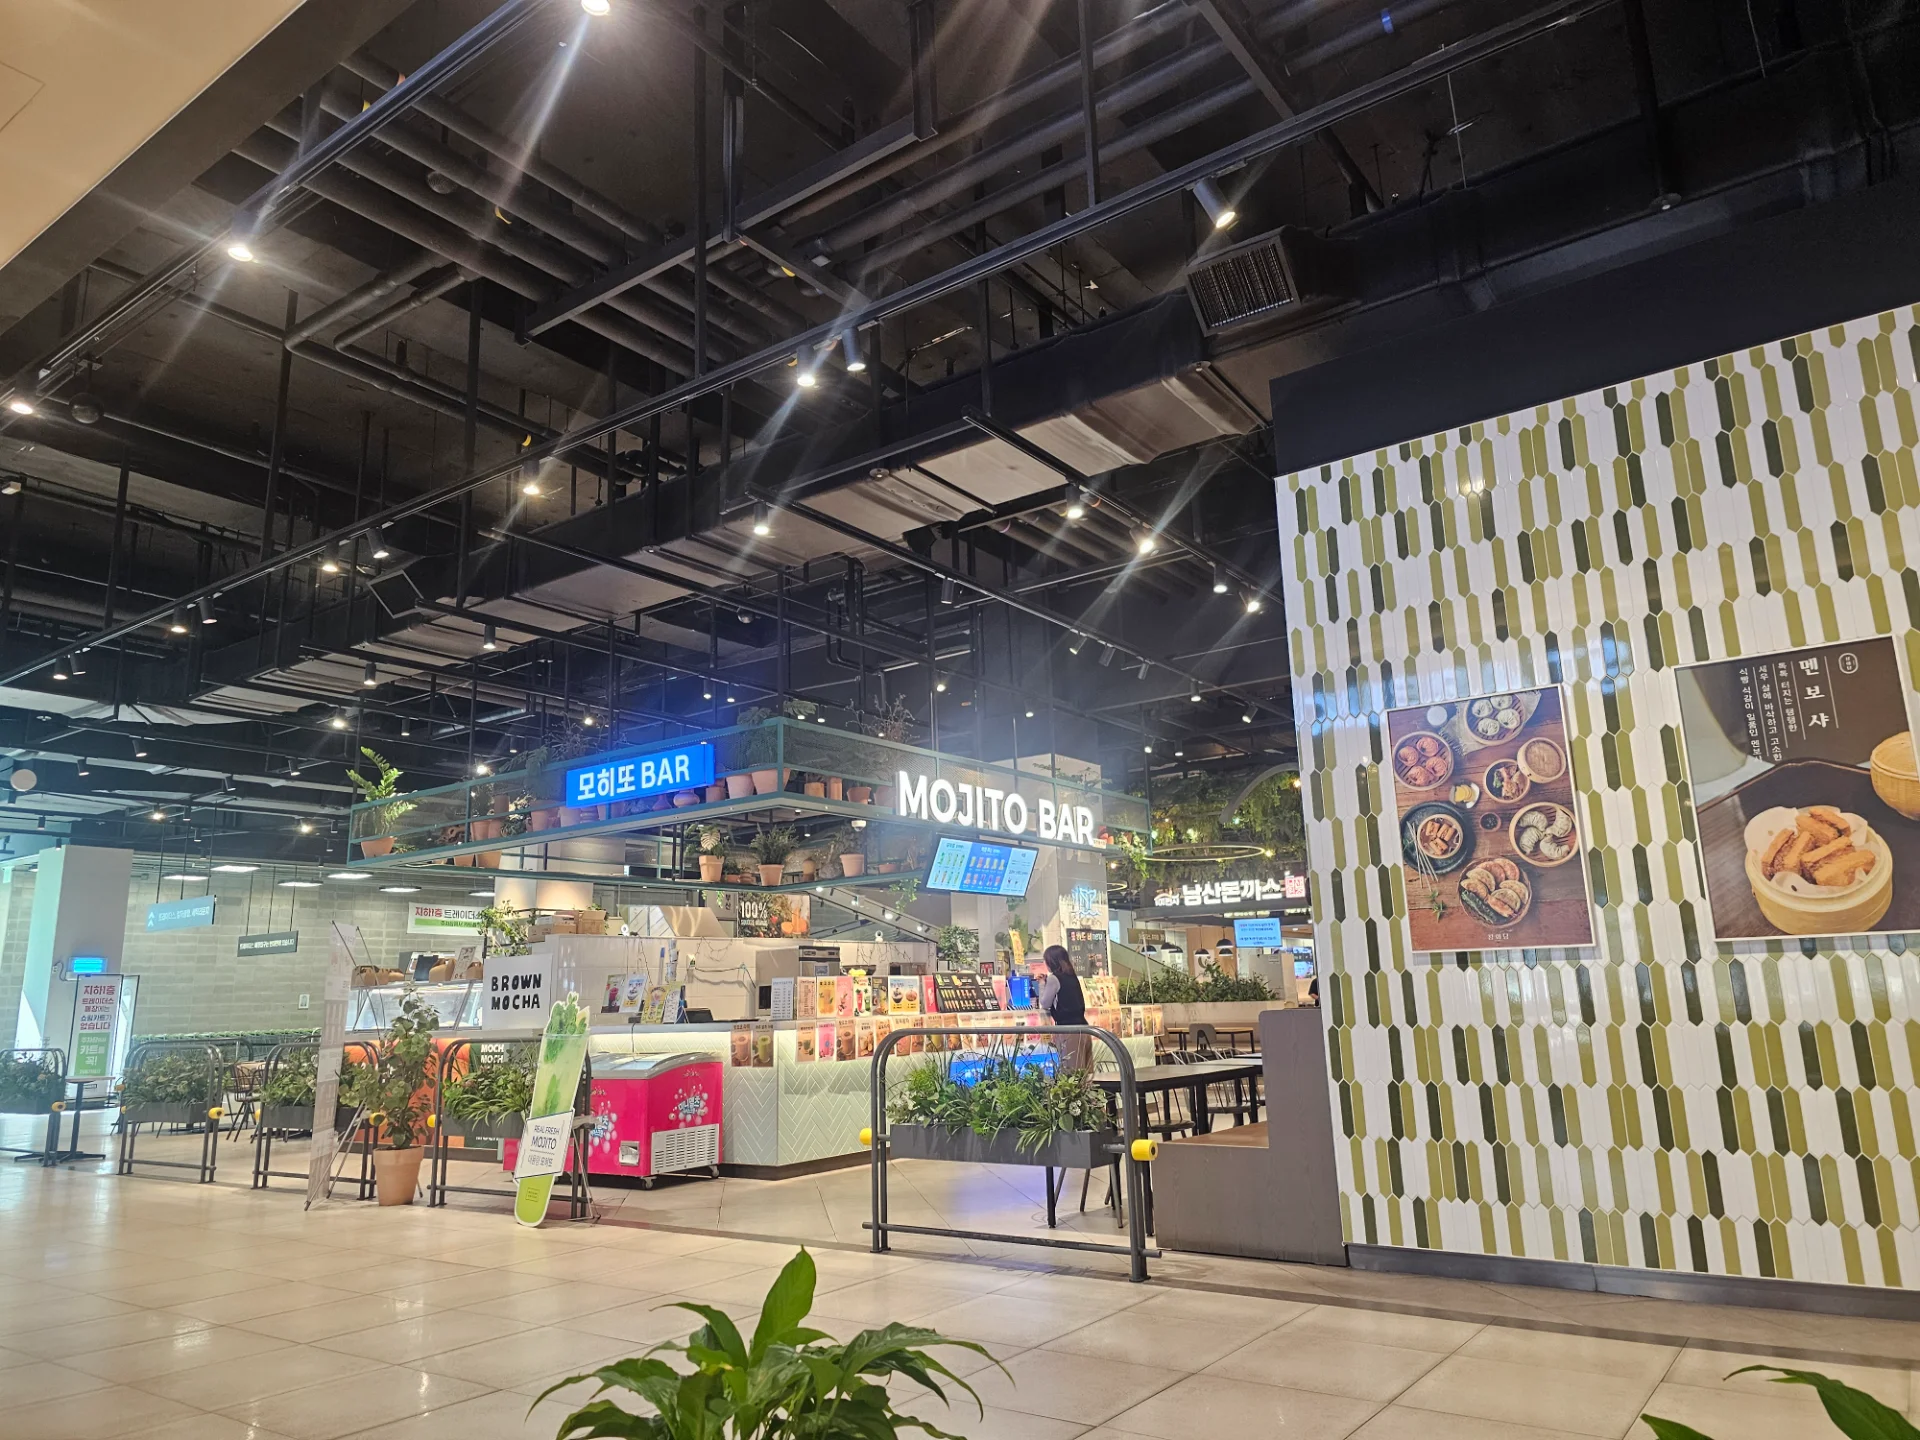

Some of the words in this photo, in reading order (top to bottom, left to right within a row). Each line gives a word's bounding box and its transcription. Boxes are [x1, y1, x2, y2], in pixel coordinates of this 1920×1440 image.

[1742, 686, 1754, 710] 식감이
[1781, 681, 1793, 705] 터지는
[1798, 657, 1830, 728] 멘보샤
[1764, 702, 1777, 734] 바삭하고
[1771, 738, 1782, 761] 고소한
[578, 764, 636, 801] 모히또
[641, 754, 690, 789] BAR
[897, 770, 1028, 835] MOJITO
[1038, 798, 1096, 847] BAR
[1182, 878, 1283, 906] 남산돈까스
[415, 907, 443, 917] 지하1층
[740, 901, 768, 919] 100%
[83, 985, 115, 995] 지하1층
[491, 973, 541, 991] BROWN
[491, 993, 540, 1011] MOCHA
[80, 1022, 111, 1030] 없습니다
[546, 1126, 560, 1135] FRESH
[531, 1136, 557, 1150] MOJITO
